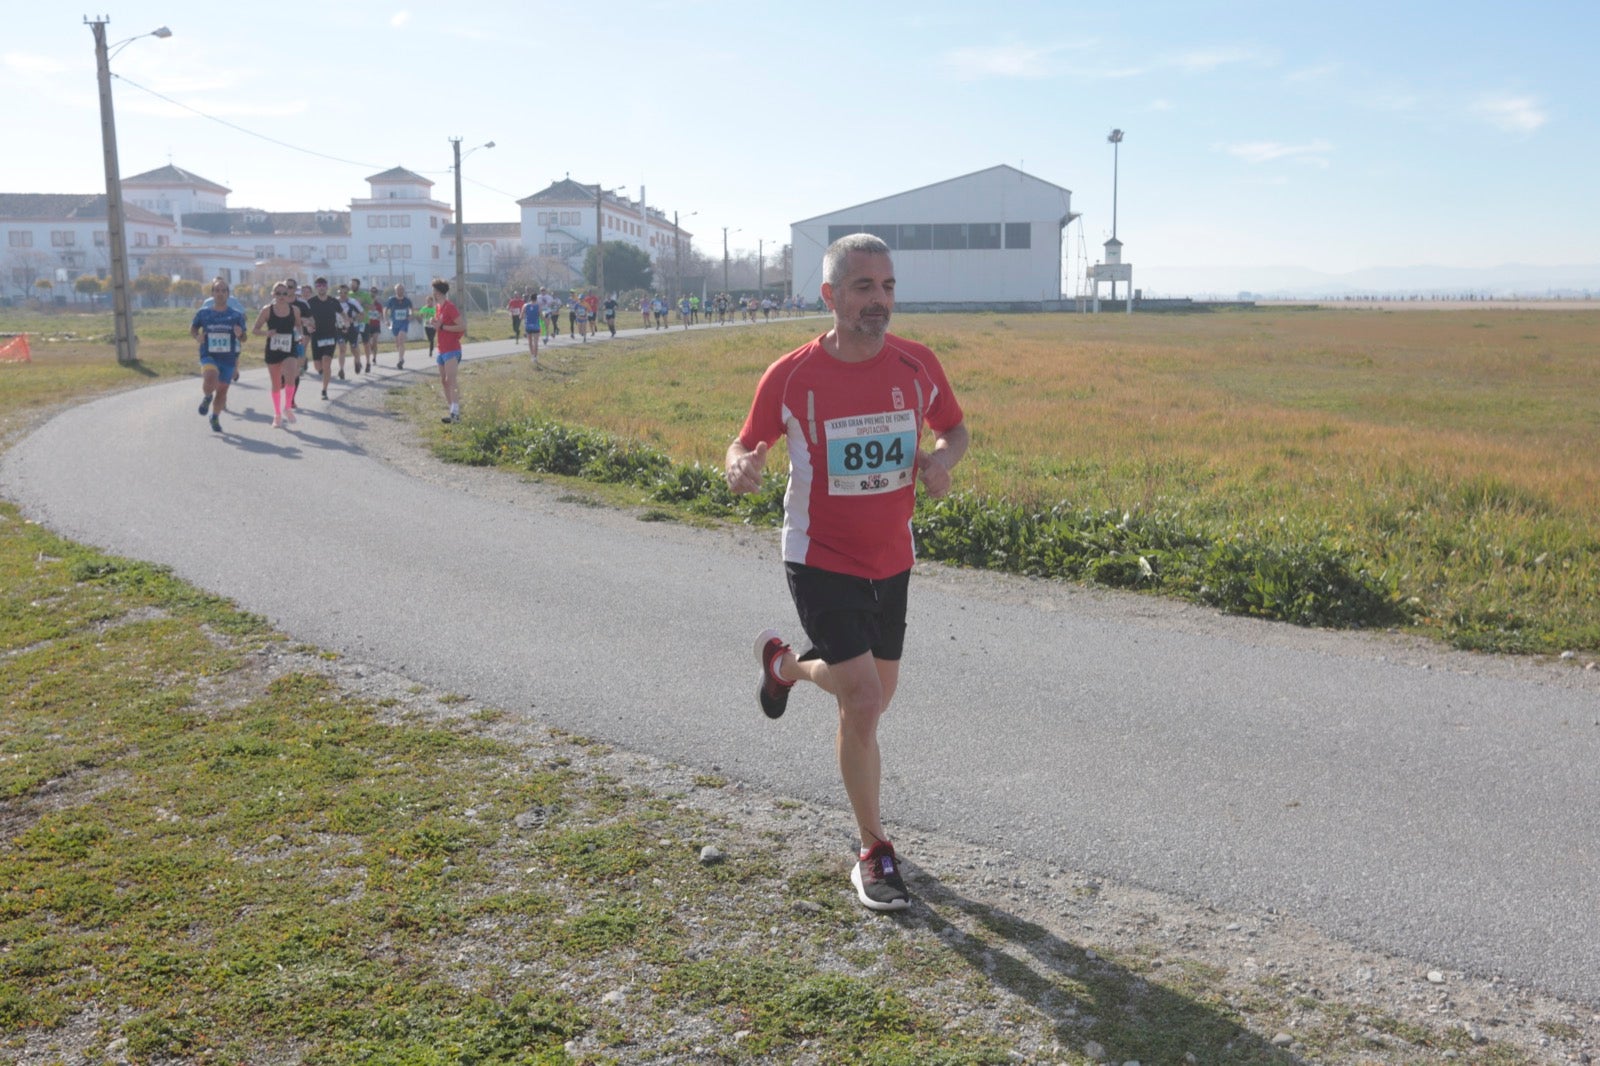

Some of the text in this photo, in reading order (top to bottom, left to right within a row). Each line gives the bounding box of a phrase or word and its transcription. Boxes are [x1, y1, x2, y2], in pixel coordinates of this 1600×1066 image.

[848, 418, 863, 427] GRAN
[864, 416, 885, 425] PREMIO
[885, 415, 892, 423] DE
[844, 437, 904, 470] 894
